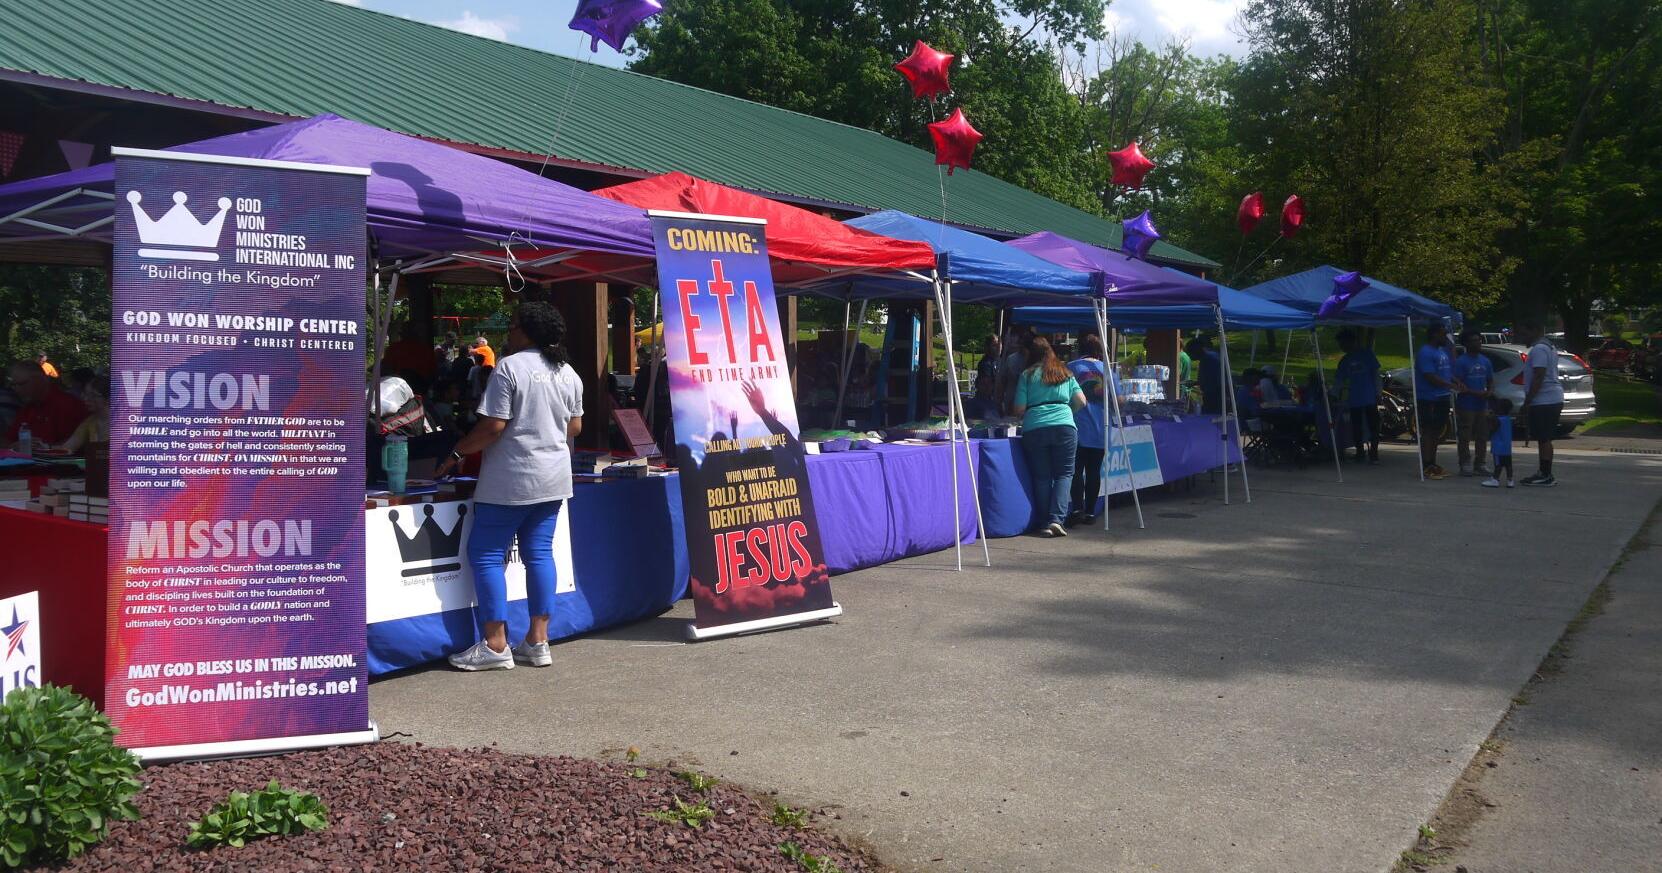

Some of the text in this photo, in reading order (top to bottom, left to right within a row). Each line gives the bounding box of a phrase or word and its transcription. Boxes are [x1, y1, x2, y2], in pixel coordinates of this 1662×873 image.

[236, 198, 261, 213] GOD
[236, 215, 264, 230] WON
[236, 232, 306, 250] MINISTRIES
[667, 227, 759, 254] COMING:
[236, 249, 354, 269] INTERNATIONAL INC
[218, 269, 241, 283] the
[123, 311, 357, 335] GOD WON WORSHIP CENTER
[127, 333, 354, 350] KINGDOM FOCUSED CHRIST CENTERED
[692, 366, 777, 383] END TIME ARMY
[122, 370, 269, 410] VISION
[149, 416, 191, 425] marching
[129, 427, 168, 435] MOBILE
[170, 428, 187, 436] and
[128, 440, 169, 450] storming
[188, 442, 213, 450] gates
[264, 442, 314, 452] consistently
[316, 443, 345, 452] seizing
[705, 440, 731, 453] CALLING
[128, 453, 176, 461] mountains
[194, 454, 232, 462] CHRIST.
[128, 466, 157, 476] willing
[180, 467, 220, 475] obedient
[277, 468, 304, 476] calling
[726, 466, 776, 483] WHO WANT TO BE
[128, 481, 151, 489] upon
[707, 479, 797, 507] BOLD & UNAFRAID
[709, 498, 801, 529] IDENTIFYING WITH
[126, 520, 311, 559] MISSION
[714, 521, 812, 594] JESUS
[126, 566, 160, 574] Reform
[176, 565, 219, 575] Apostolic
[221, 564, 253, 572] Church
[256, 563, 272, 571] that
[275, 564, 313, 572] operates
[126, 580, 149, 588] body
[164, 578, 201, 586] CHRIST
[215, 577, 247, 586] leading
[266, 576, 296, 584] culture
[310, 575, 348, 583] freedom,
[146, 592, 190, 601] discipling
[192, 591, 212, 599] lives
[215, 590, 234, 598] built
[267, 588, 313, 596] foundation
[316, 587, 325, 595] of
[126, 605, 166, 614] CHRIST.
[169, 605, 177, 613] In
[180, 604, 204, 612] order
[219, 603, 240, 611] build
[250, 601, 281, 610] GODLY
[284, 601, 311, 609] nation
[314, 600, 330, 608] and
[126, 619, 171, 628] ultimately
[174, 618, 203, 626] GOD's
[206, 616, 246, 626] Kingdom
[248, 616, 271, 624] upon
[290, 613, 314, 621] earth.
[128, 654, 356, 679] MAY GOD BLESS US IN THIS MISSION.
[126, 677, 358, 707] GodWonMinistries.net
